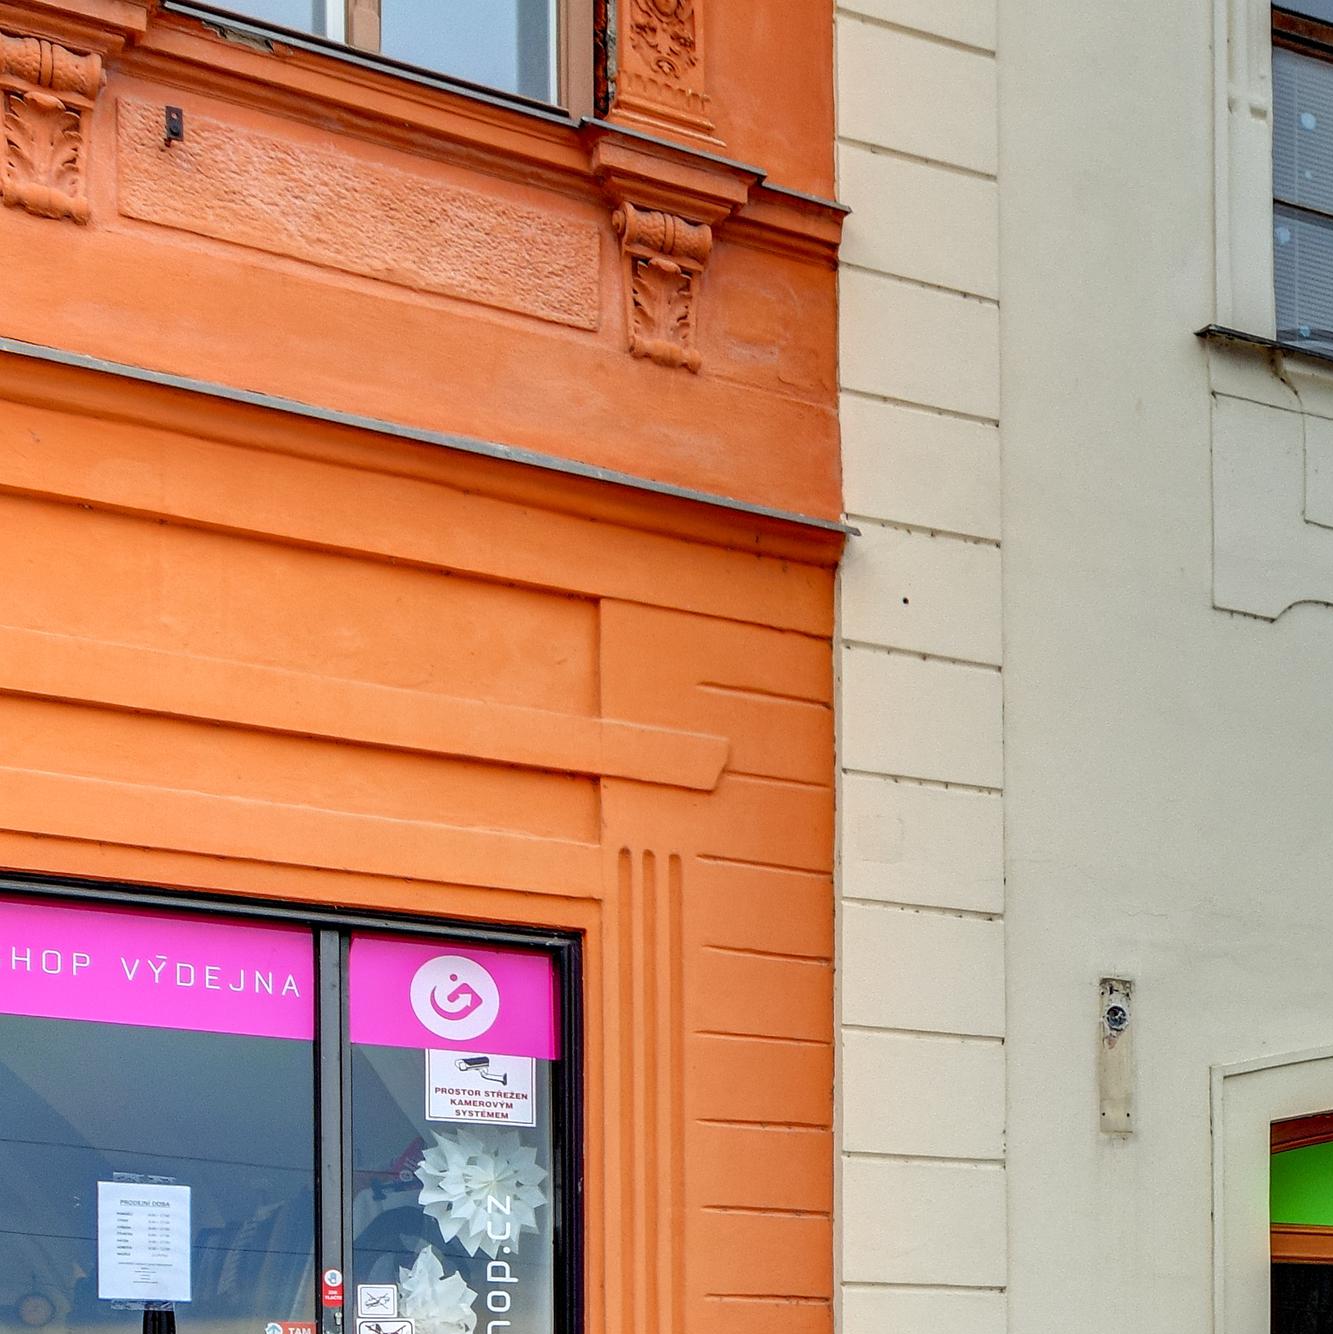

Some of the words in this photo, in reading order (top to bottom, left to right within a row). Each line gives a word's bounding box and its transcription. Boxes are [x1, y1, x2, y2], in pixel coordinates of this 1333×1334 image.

[11, 946, 91, 976] HOP
[434, 1086, 481, 1097] PROSTOR
[484, 1089, 528, 1100] STŘEŽEN
[450, 1098, 513, 1109] KAMEROVÝM
[455, 1109, 509, 1119] SYSTÉMEM
